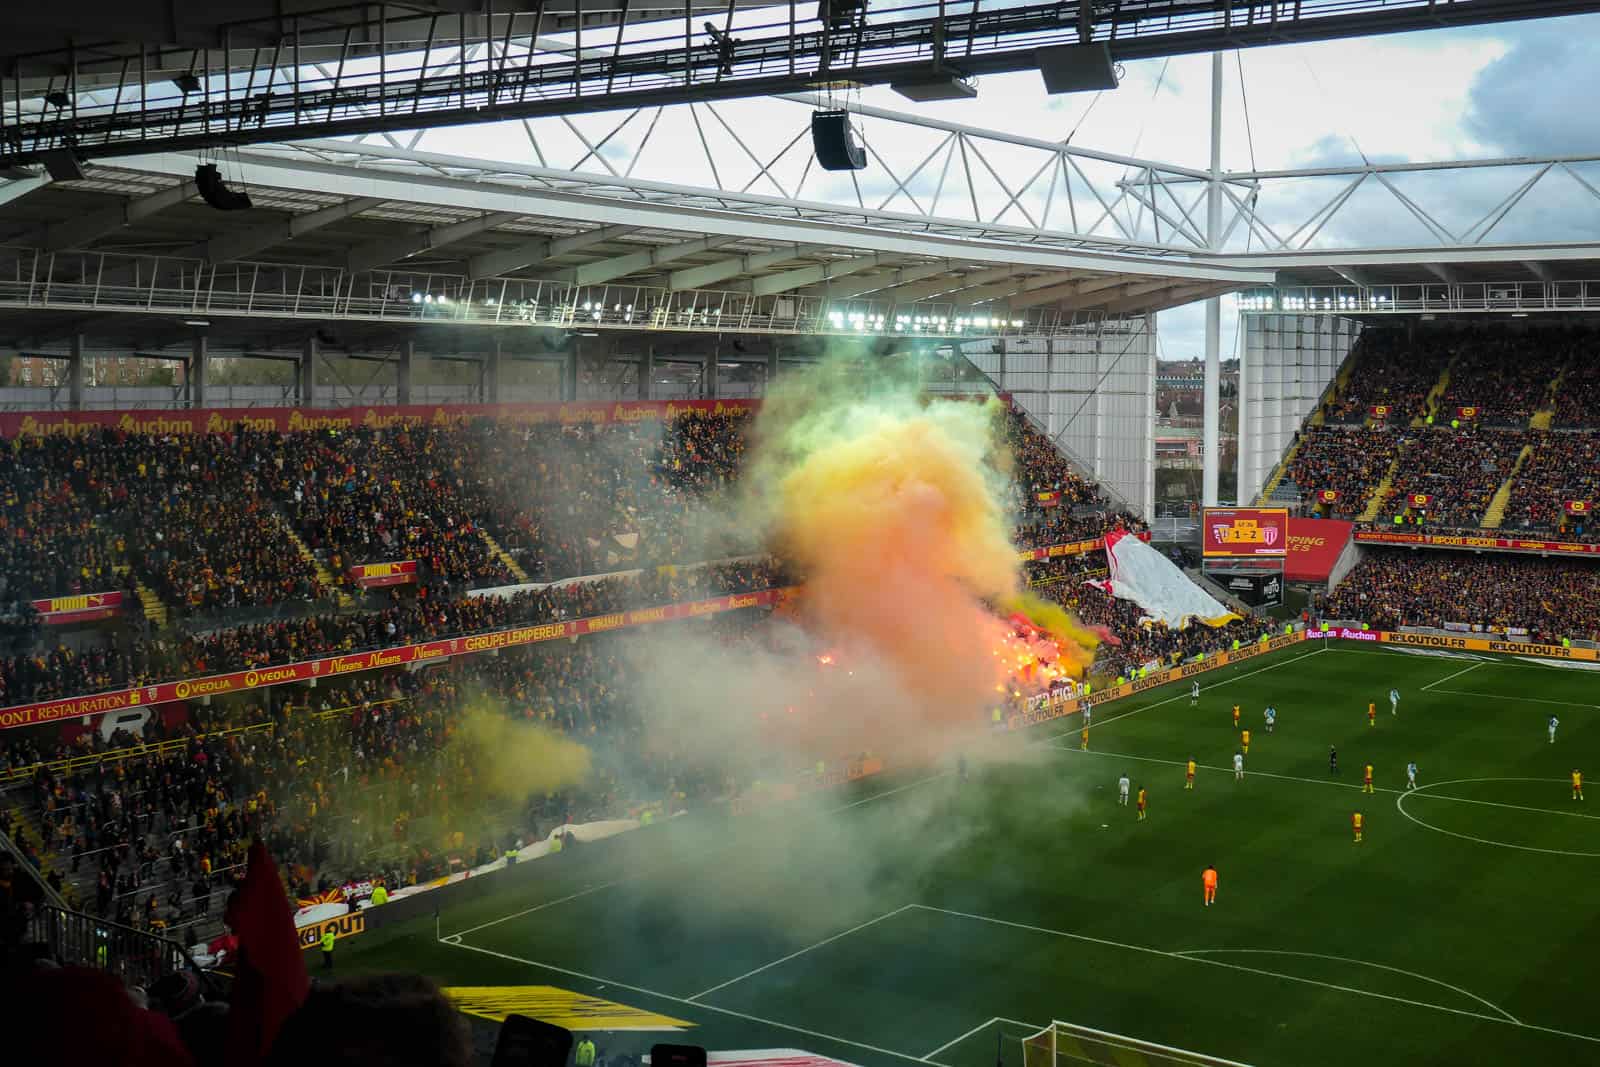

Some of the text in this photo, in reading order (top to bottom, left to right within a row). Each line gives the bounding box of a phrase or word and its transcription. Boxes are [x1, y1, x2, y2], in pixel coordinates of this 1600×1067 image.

[120, 412, 193, 434] Auchan
[50, 594, 88, 613] PUMA
[464, 624, 566, 652] GROUPE LEMPEREUR
[1306, 628, 1376, 641] Aucan Auchan
[367, 651, 402, 668] Nexans
[260, 668, 297, 685] VEOLIA
[191, 679, 233, 695] VEOLIA
[37, 695, 126, 718] RESTAURATION
